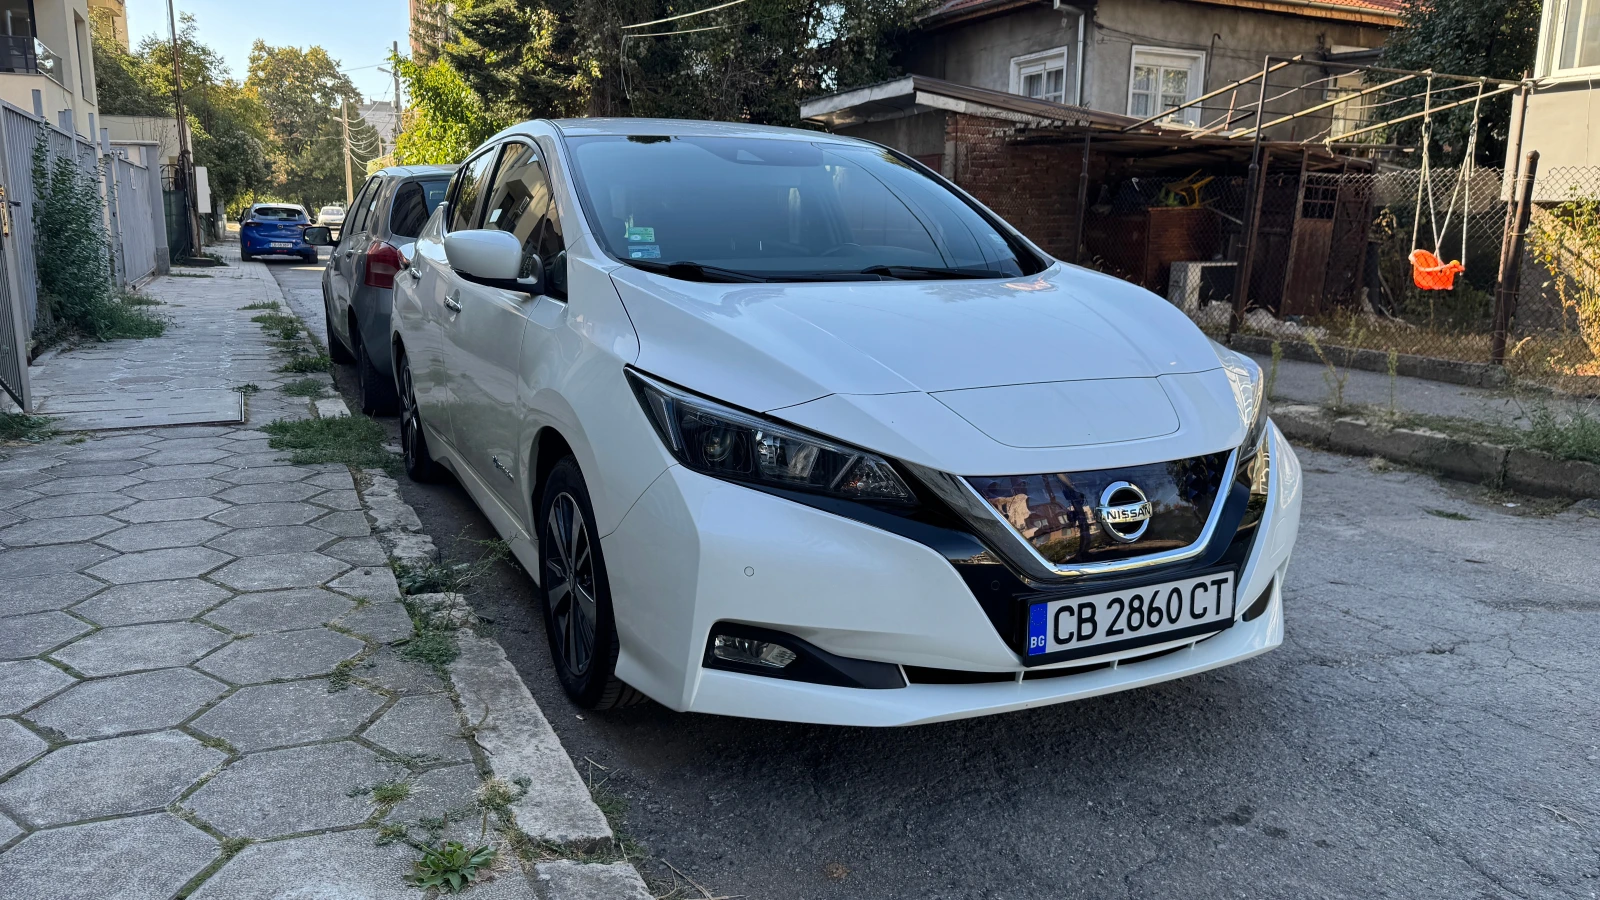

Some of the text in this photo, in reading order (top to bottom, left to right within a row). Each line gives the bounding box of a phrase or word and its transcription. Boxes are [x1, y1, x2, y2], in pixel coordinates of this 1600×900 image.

[1106, 506, 1151, 520] NISSAN
[1053, 577, 1229, 645] CB 2860 CT
[1030, 635, 1045, 649] BG
